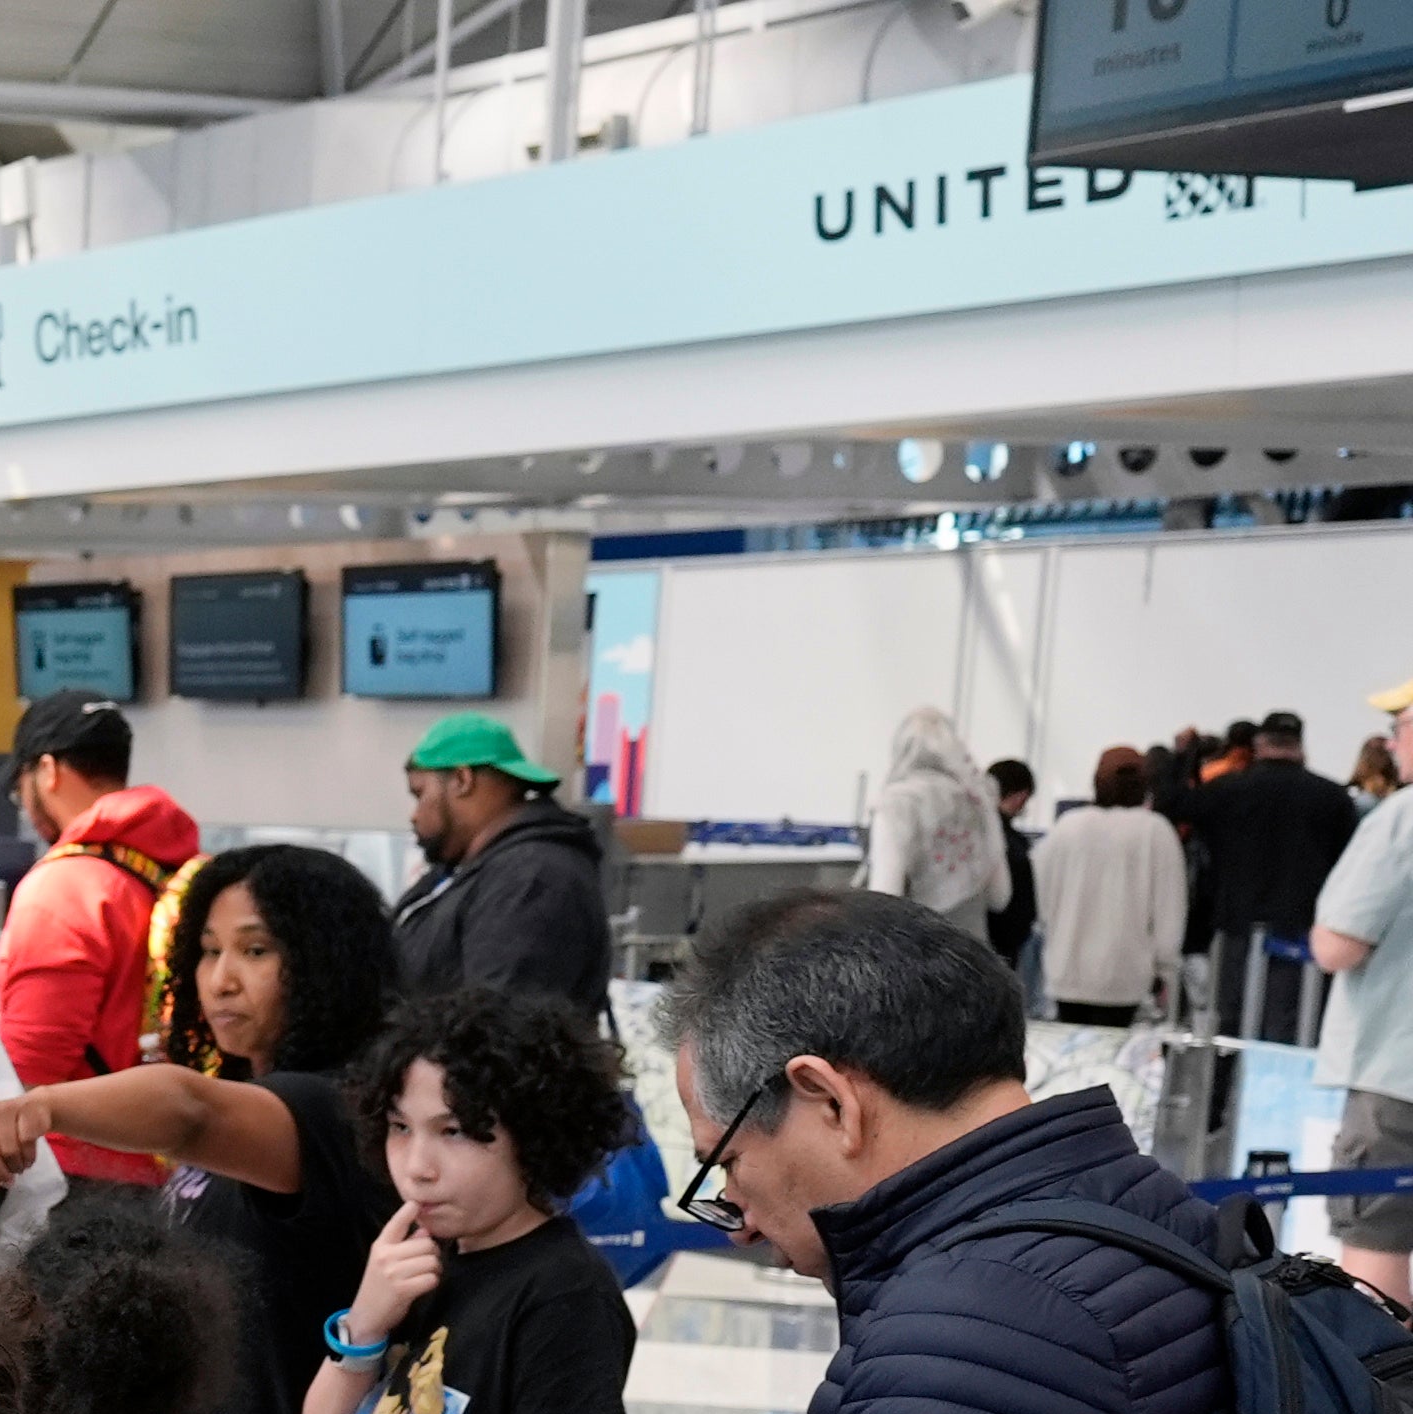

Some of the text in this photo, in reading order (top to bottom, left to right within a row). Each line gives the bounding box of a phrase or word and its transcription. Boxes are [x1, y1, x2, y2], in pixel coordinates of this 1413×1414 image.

[1093, 32, 1364, 77] minutes minute
[815, 166, 1134, 241] UNITED
[35, 295, 197, 364] Check-in
